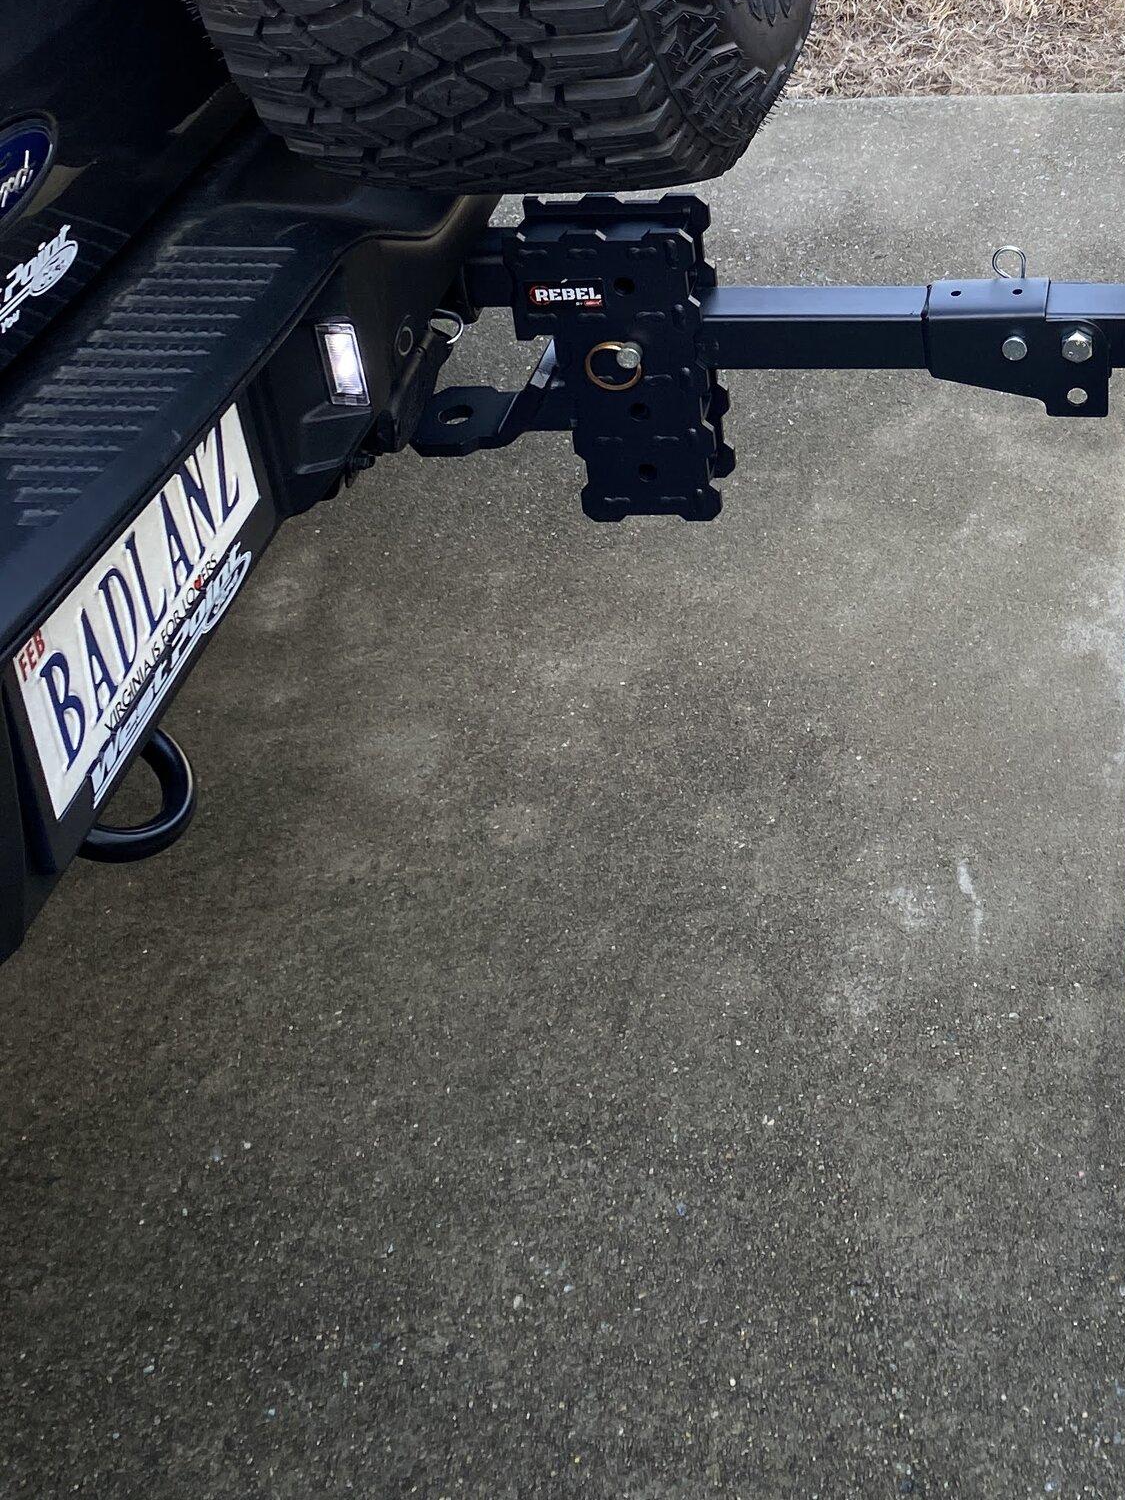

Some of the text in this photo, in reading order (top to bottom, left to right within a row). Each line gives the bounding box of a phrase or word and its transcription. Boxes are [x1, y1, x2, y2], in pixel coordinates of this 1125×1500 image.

[534, 286, 602, 301] REBEL
[39, 420, 240, 772] BADLANZ
[18, 629, 46, 682] FEB
[104, 662, 154, 734] VIRGINIA
[151, 642, 162, 664] IS
[160, 610, 185, 648] FOR
